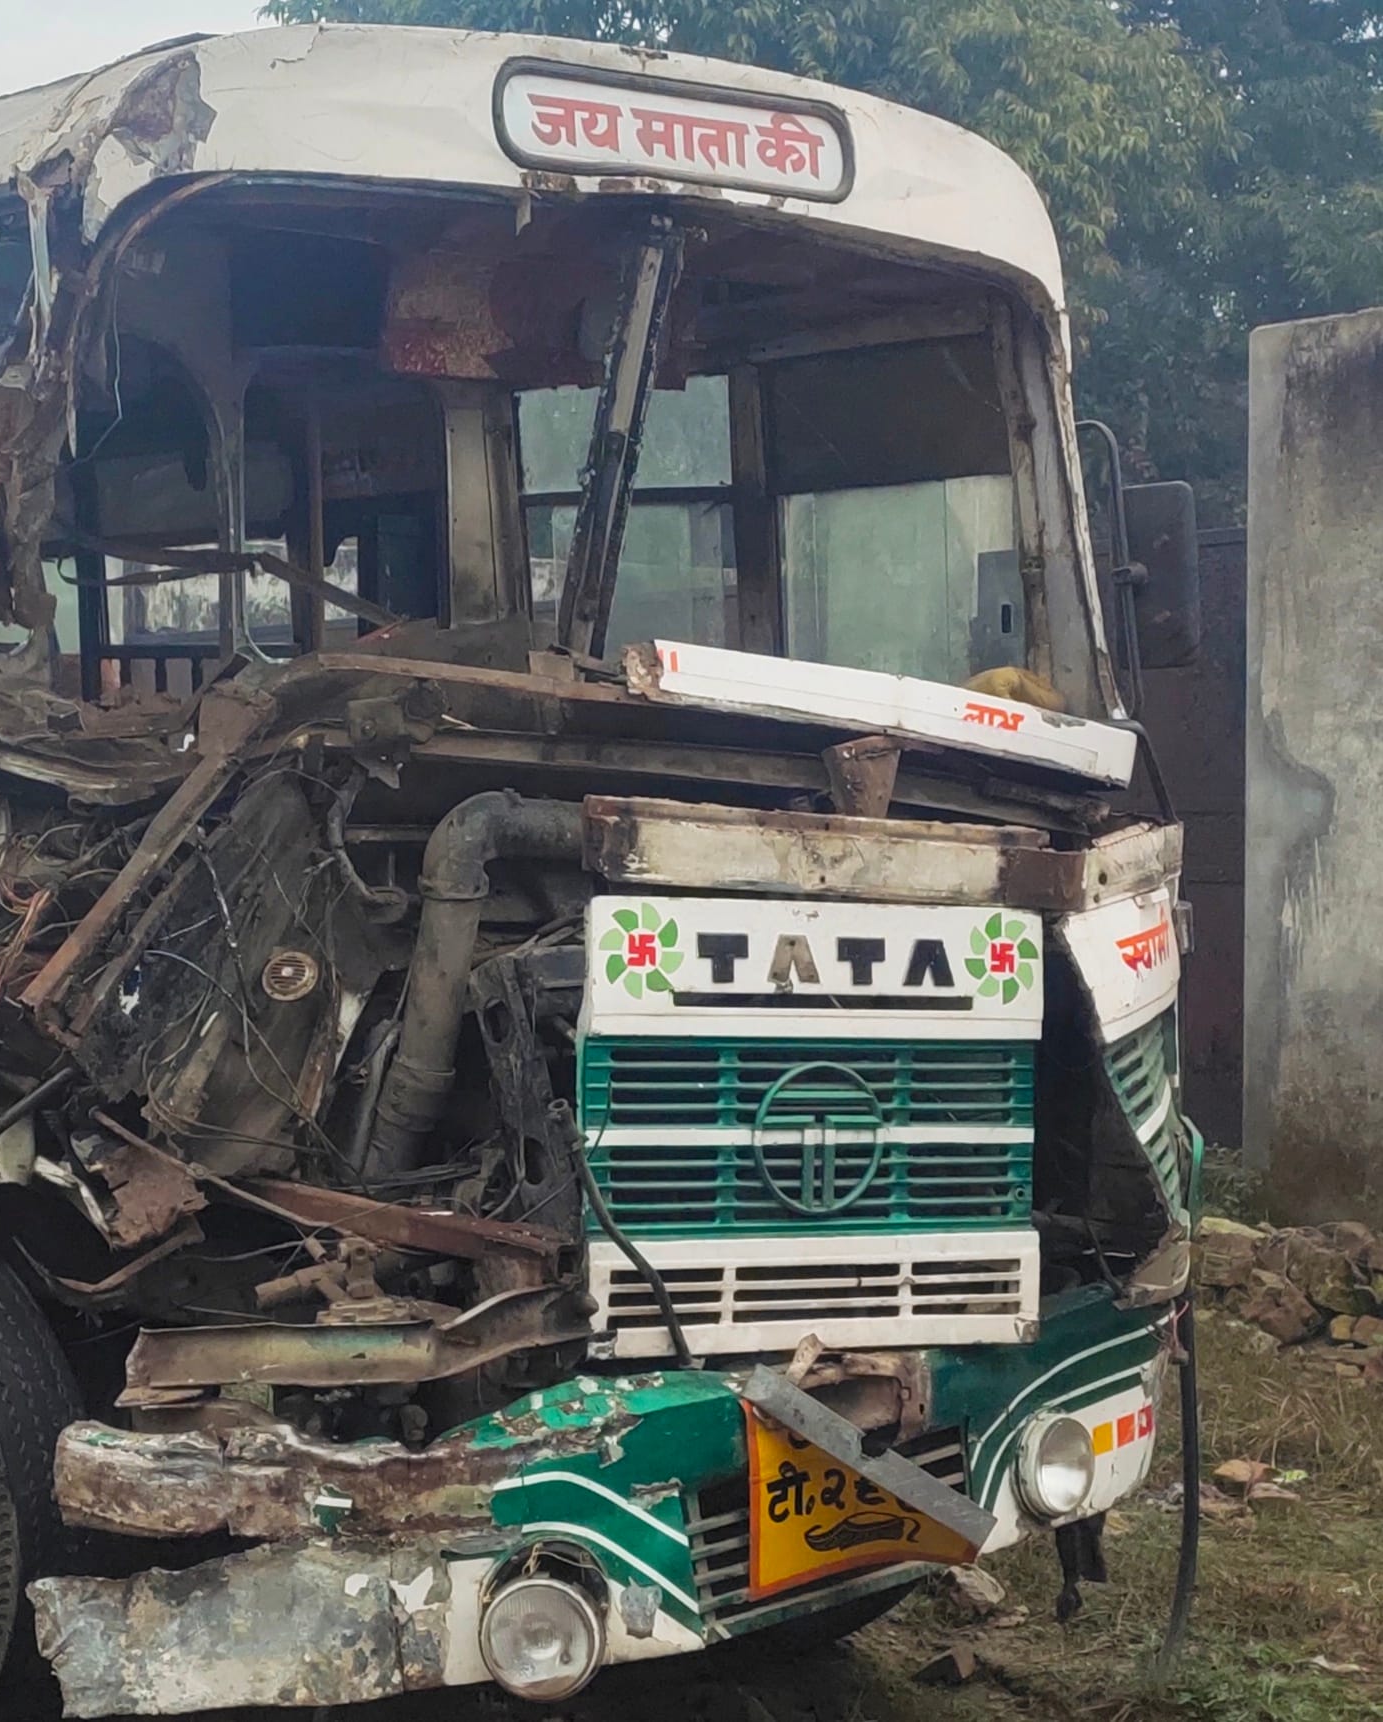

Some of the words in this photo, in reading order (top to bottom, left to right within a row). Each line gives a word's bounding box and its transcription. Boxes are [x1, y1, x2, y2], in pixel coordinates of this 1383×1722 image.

[526, 93, 622, 153] जय
[629, 107, 750, 170] माता
[754, 111, 825, 180] की
[696, 932, 956, 988] TATA
